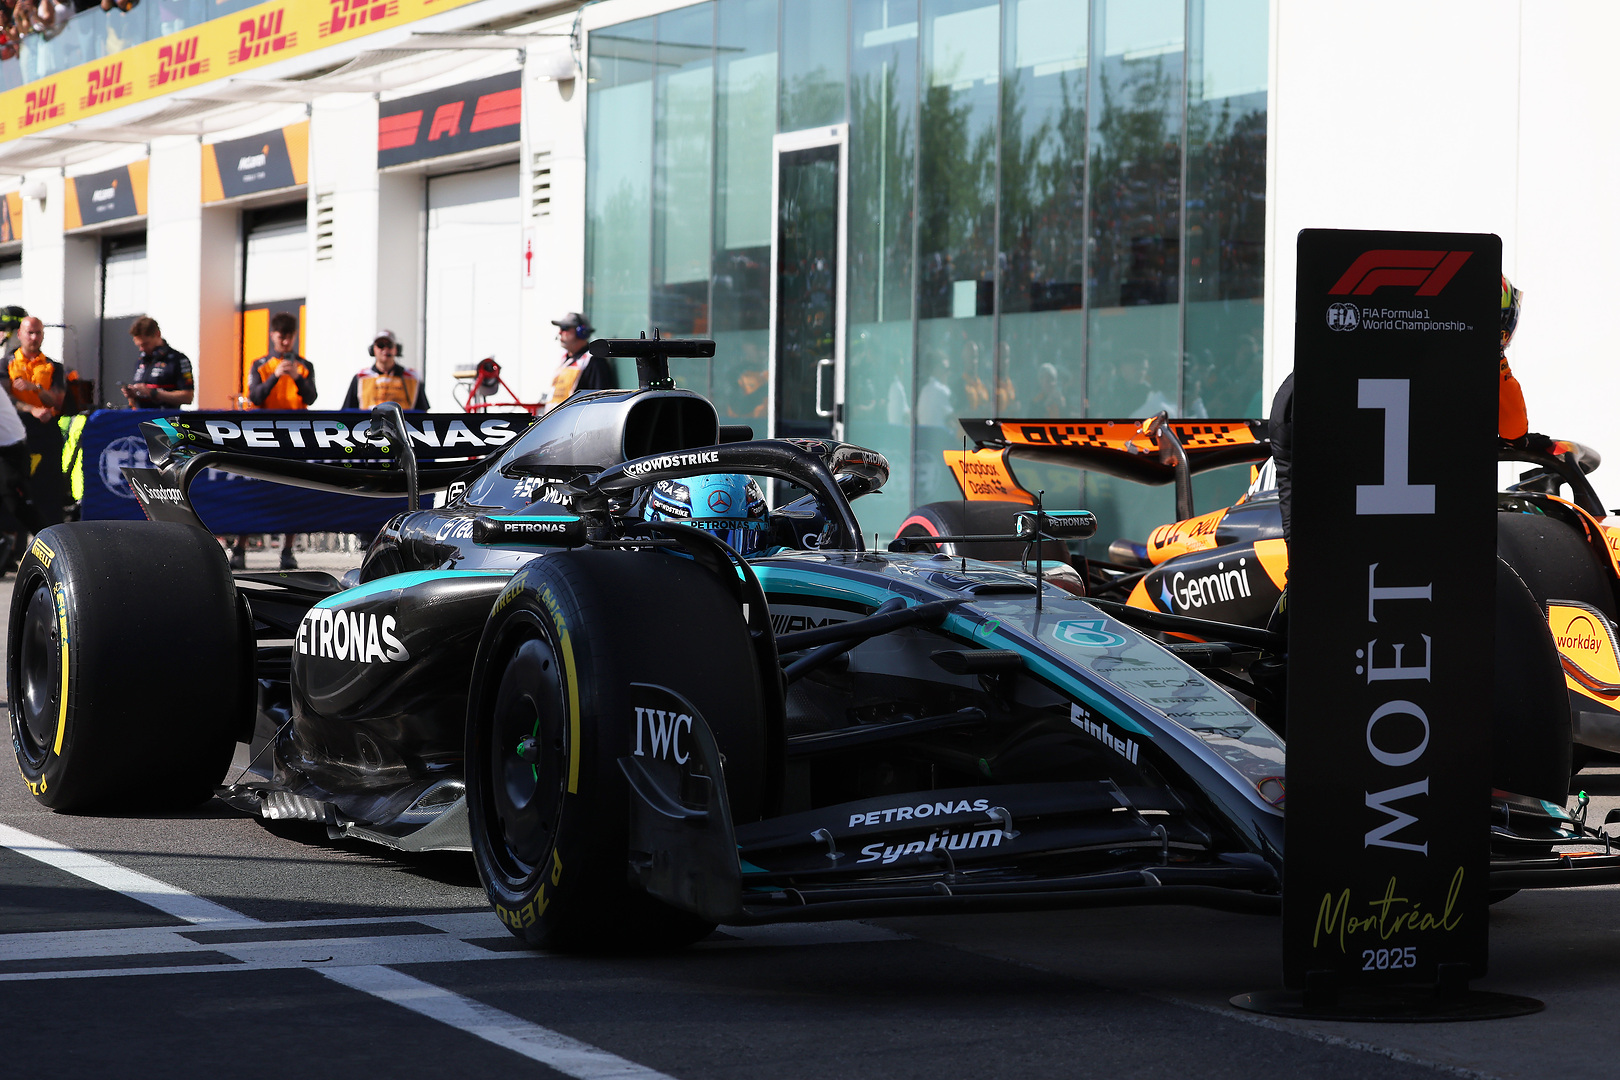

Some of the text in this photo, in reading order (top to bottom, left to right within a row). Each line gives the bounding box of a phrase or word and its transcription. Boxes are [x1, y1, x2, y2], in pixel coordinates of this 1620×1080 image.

[238, 8, 287, 62] DHL
[157, 36, 201, 85] DHL
[87, 61, 125, 107] DHL
[25, 83, 58, 126] DHL
[1362, 308, 1430, 319] FIA Formula 1
[1362, 320, 1393, 330] World
[1394, 320, 1466, 332] Championship
[205, 419, 519, 448] PETRONAS
[1356, 378, 1436, 515] 1
[628, 451, 719, 475] CROWDSTRIKE
[959, 460, 1000, 478] Dropbox
[968, 480, 997, 494] Dash
[504, 523, 566, 533] PETRONAS
[691, 521, 750, 530] PETRONAS
[1048, 518, 1090, 527] PETRONAS
[1172, 557, 1252, 611] Gemini
[1557, 634, 1602, 654] workday
[1356, 562, 1433, 857] MOËT
[634, 706, 693, 765] IWC
[1070, 702, 1139, 766] Einhell
[848, 799, 989, 828] PETRONAS
[856, 829, 1004, 864] Syntium
[496, 882, 550, 929] ZERO
[1312, 866, 1465, 954] Montréal
[1361, 946, 1417, 972] 2025
